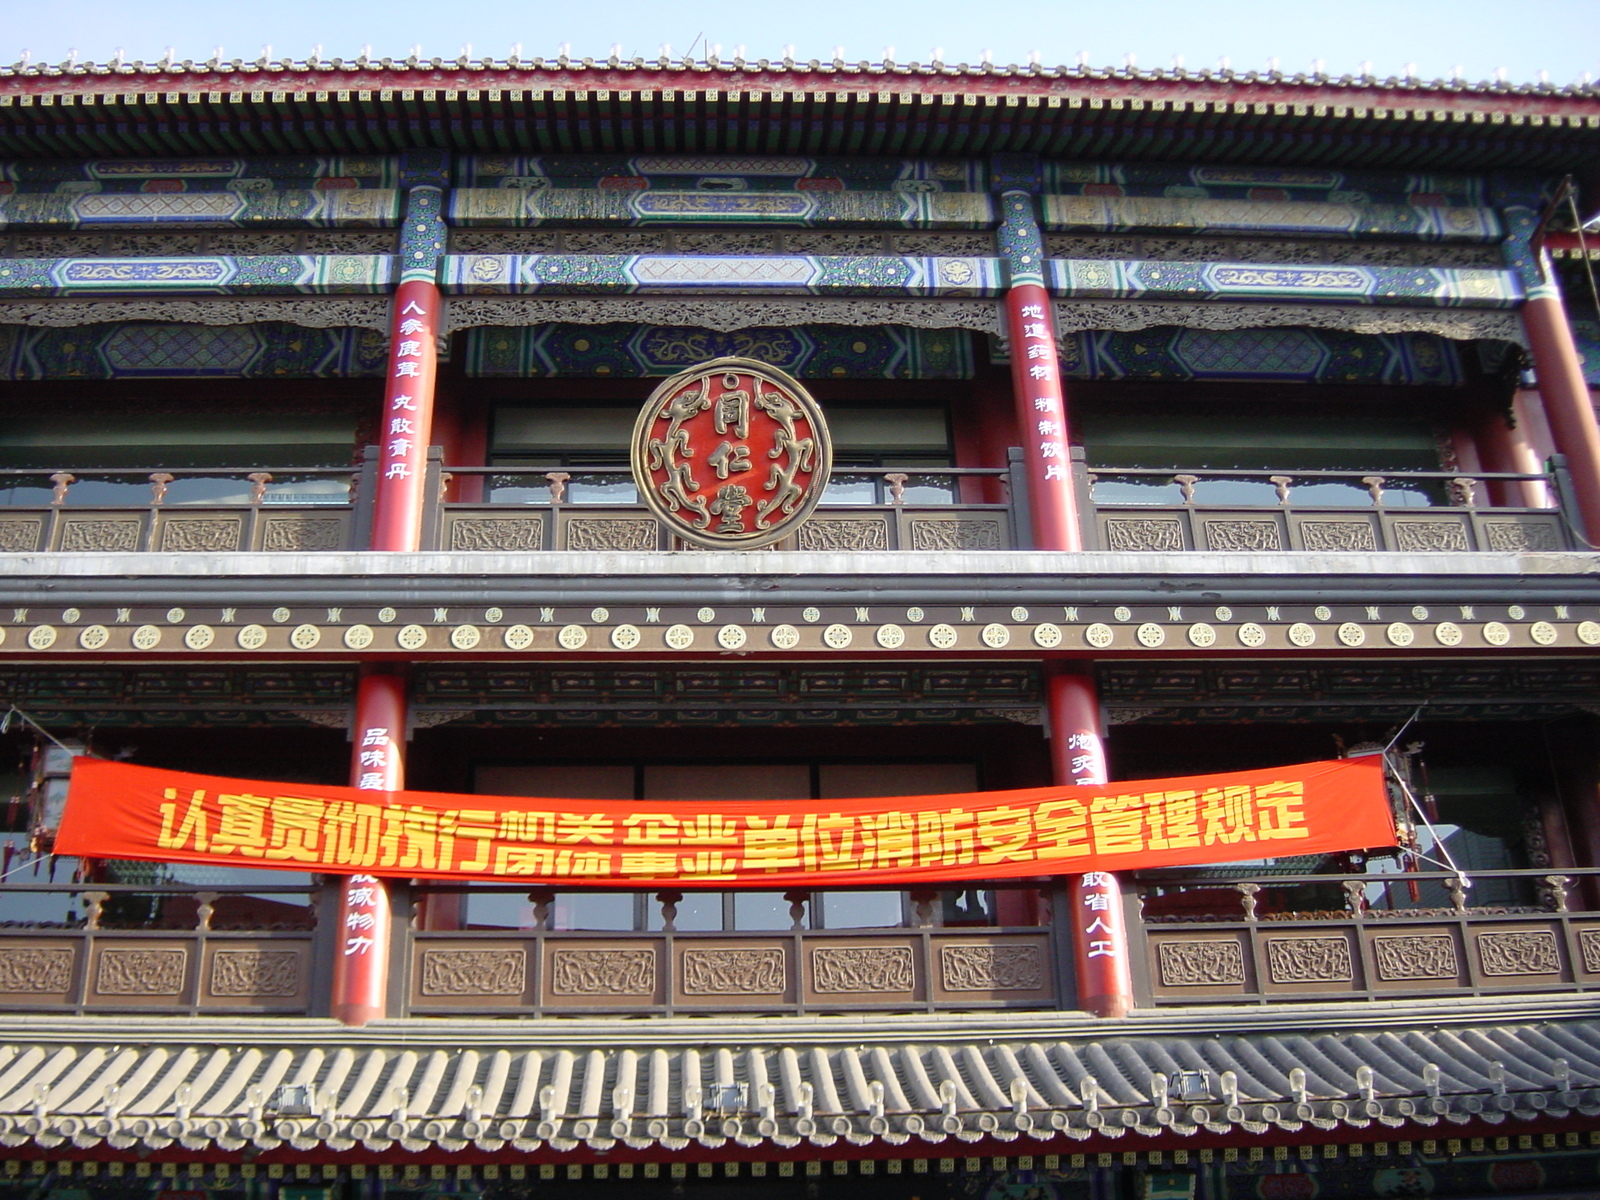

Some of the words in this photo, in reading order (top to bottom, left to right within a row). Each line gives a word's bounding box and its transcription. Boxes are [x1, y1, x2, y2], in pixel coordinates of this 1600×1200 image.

[395, 300, 427, 378] 人参鹿茸
[1021, 304, 1053, 381] 地道药材
[385, 394, 417, 480] 丸散膏丹
[708, 390, 753, 533] 同仁堂
[1034, 397, 1068, 481] 精制饮片
[157, 787, 497, 872] 认真贯彻执行
[498, 810, 614, 845] 机关
[621, 813, 739, 846] 企业
[742, 780, 1310, 873] 单位消防安全管理规定
[494, 846, 613, 879] 团体
[618, 851, 739, 881] 事业
